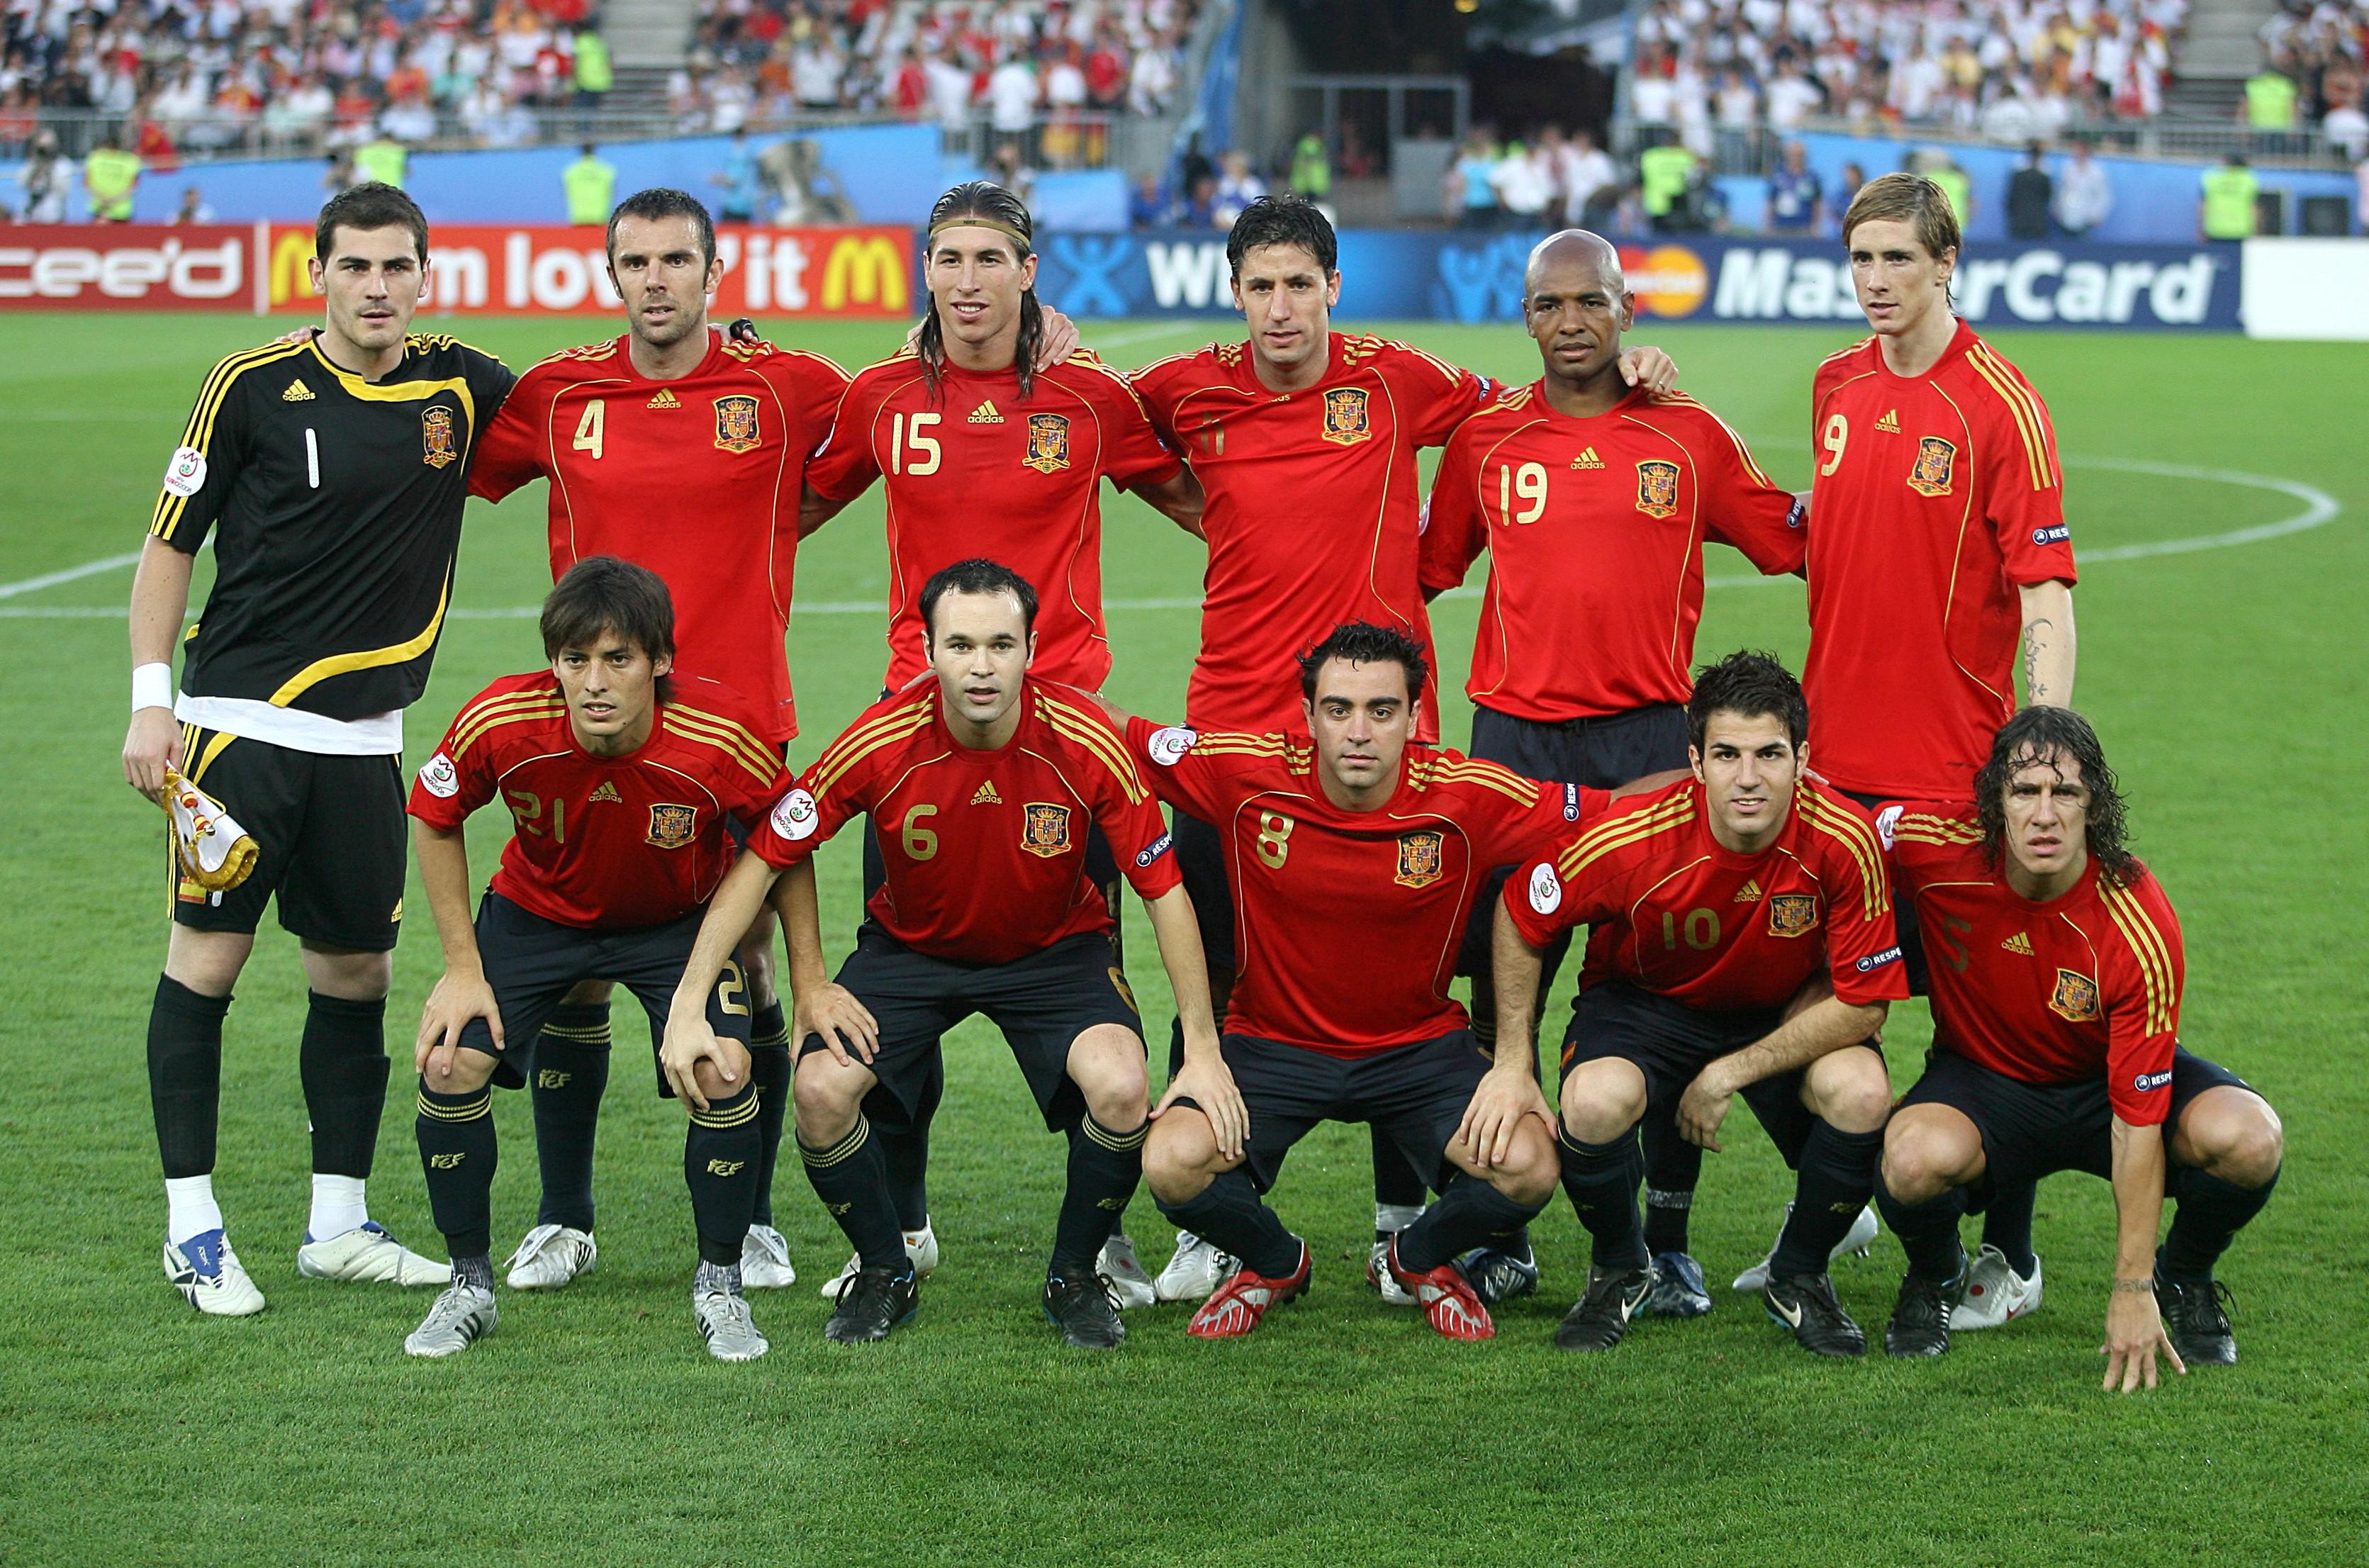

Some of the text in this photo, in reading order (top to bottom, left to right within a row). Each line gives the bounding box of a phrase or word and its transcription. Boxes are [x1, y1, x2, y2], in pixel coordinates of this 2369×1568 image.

[746, 233, 809, 310] it
[282, 392, 316, 401] adidas
[967, 415, 1004, 423] adidas
[306, 427, 319, 488] 1
[572, 399, 605, 459] 4
[892, 413, 941, 475] 15
[1821, 414, 1848, 476] 9
[1500, 462, 1547, 526] 19
[1570, 461, 1606, 470] adidas
[509, 790, 564, 844] 21
[970, 794, 1002, 805] adidas
[902, 804, 938, 861] 6
[1257, 809, 1294, 869] 8
[1662, 907, 1720, 951] 10
[1943, 915, 1971, 973] 5
[2001, 941, 2034, 956] adidas
[718, 959, 749, 1017] 2
